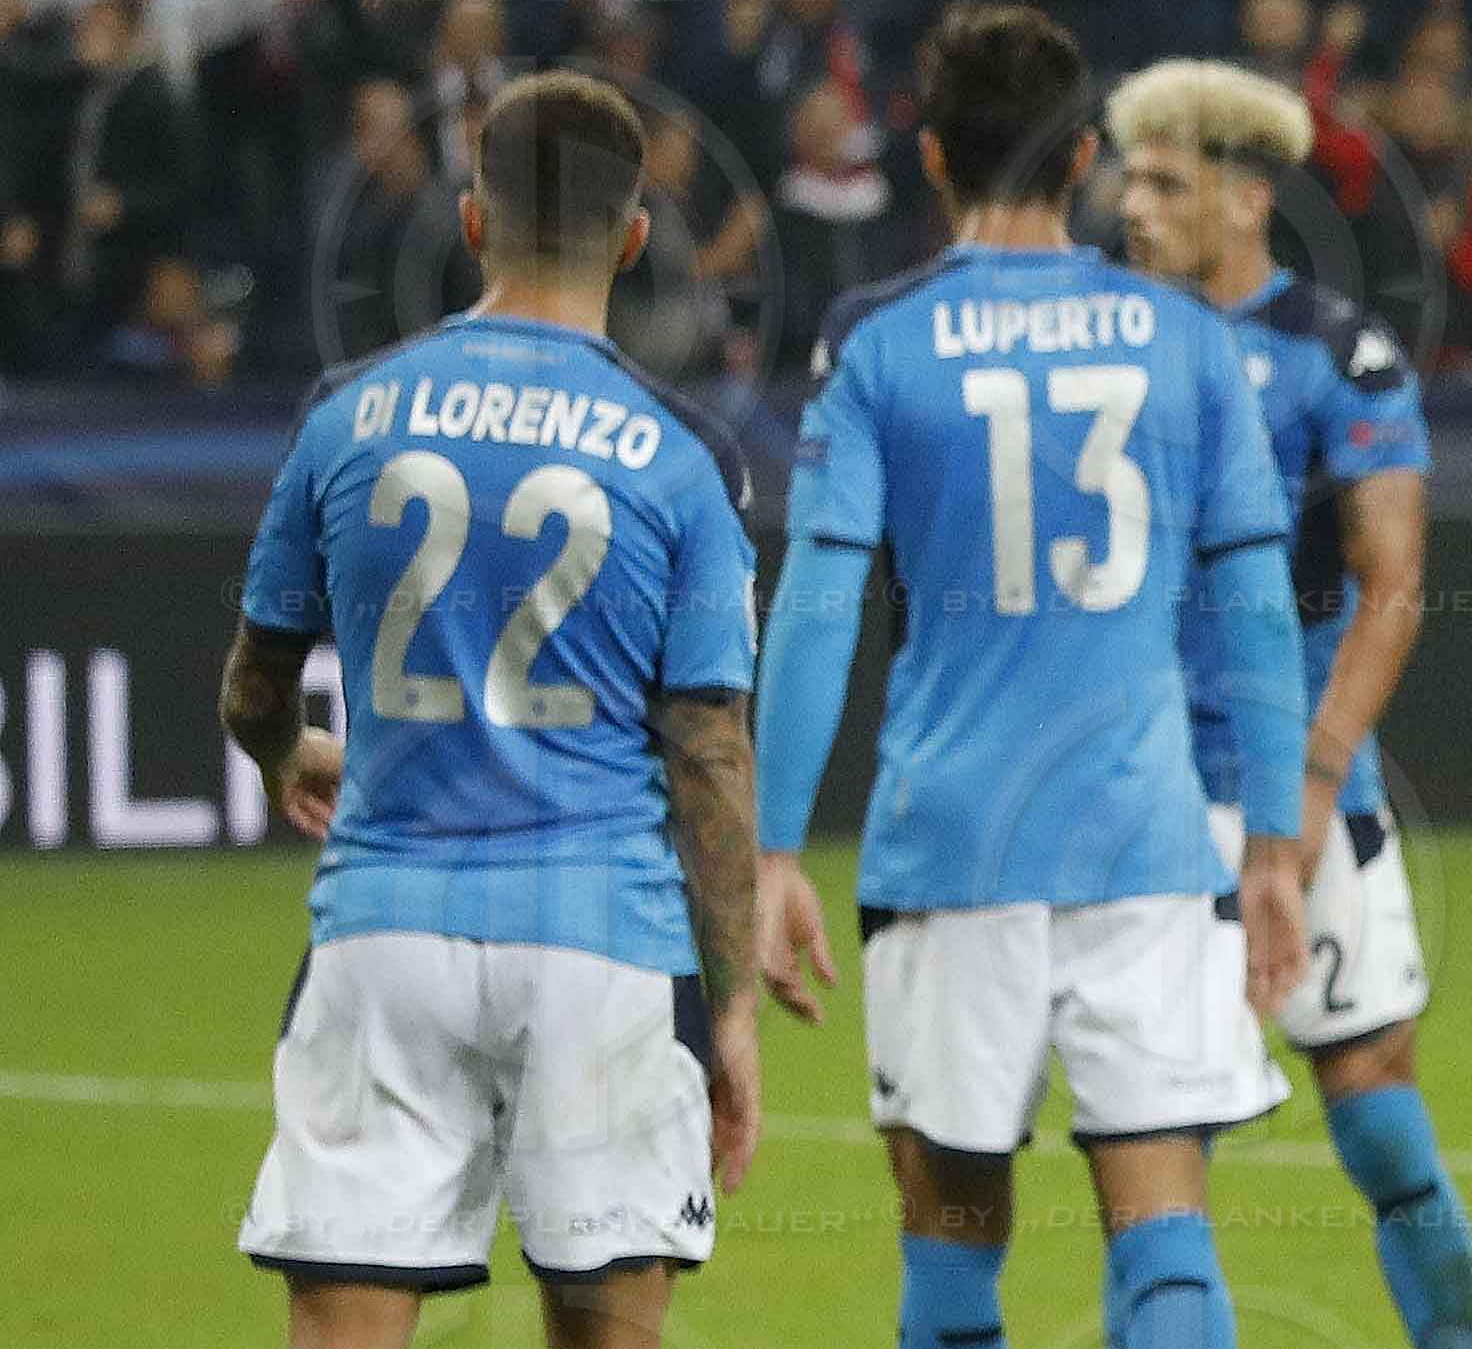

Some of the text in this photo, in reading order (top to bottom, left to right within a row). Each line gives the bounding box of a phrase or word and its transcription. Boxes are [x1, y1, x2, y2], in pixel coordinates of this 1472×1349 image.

[933, 293, 1157, 360] LUPERTO
[354, 376, 662, 471] DI LORENZO
[961, 364, 1150, 617] 13
[367, 448, 613, 729] 22
[1311, 933, 1357, 1014] 2
